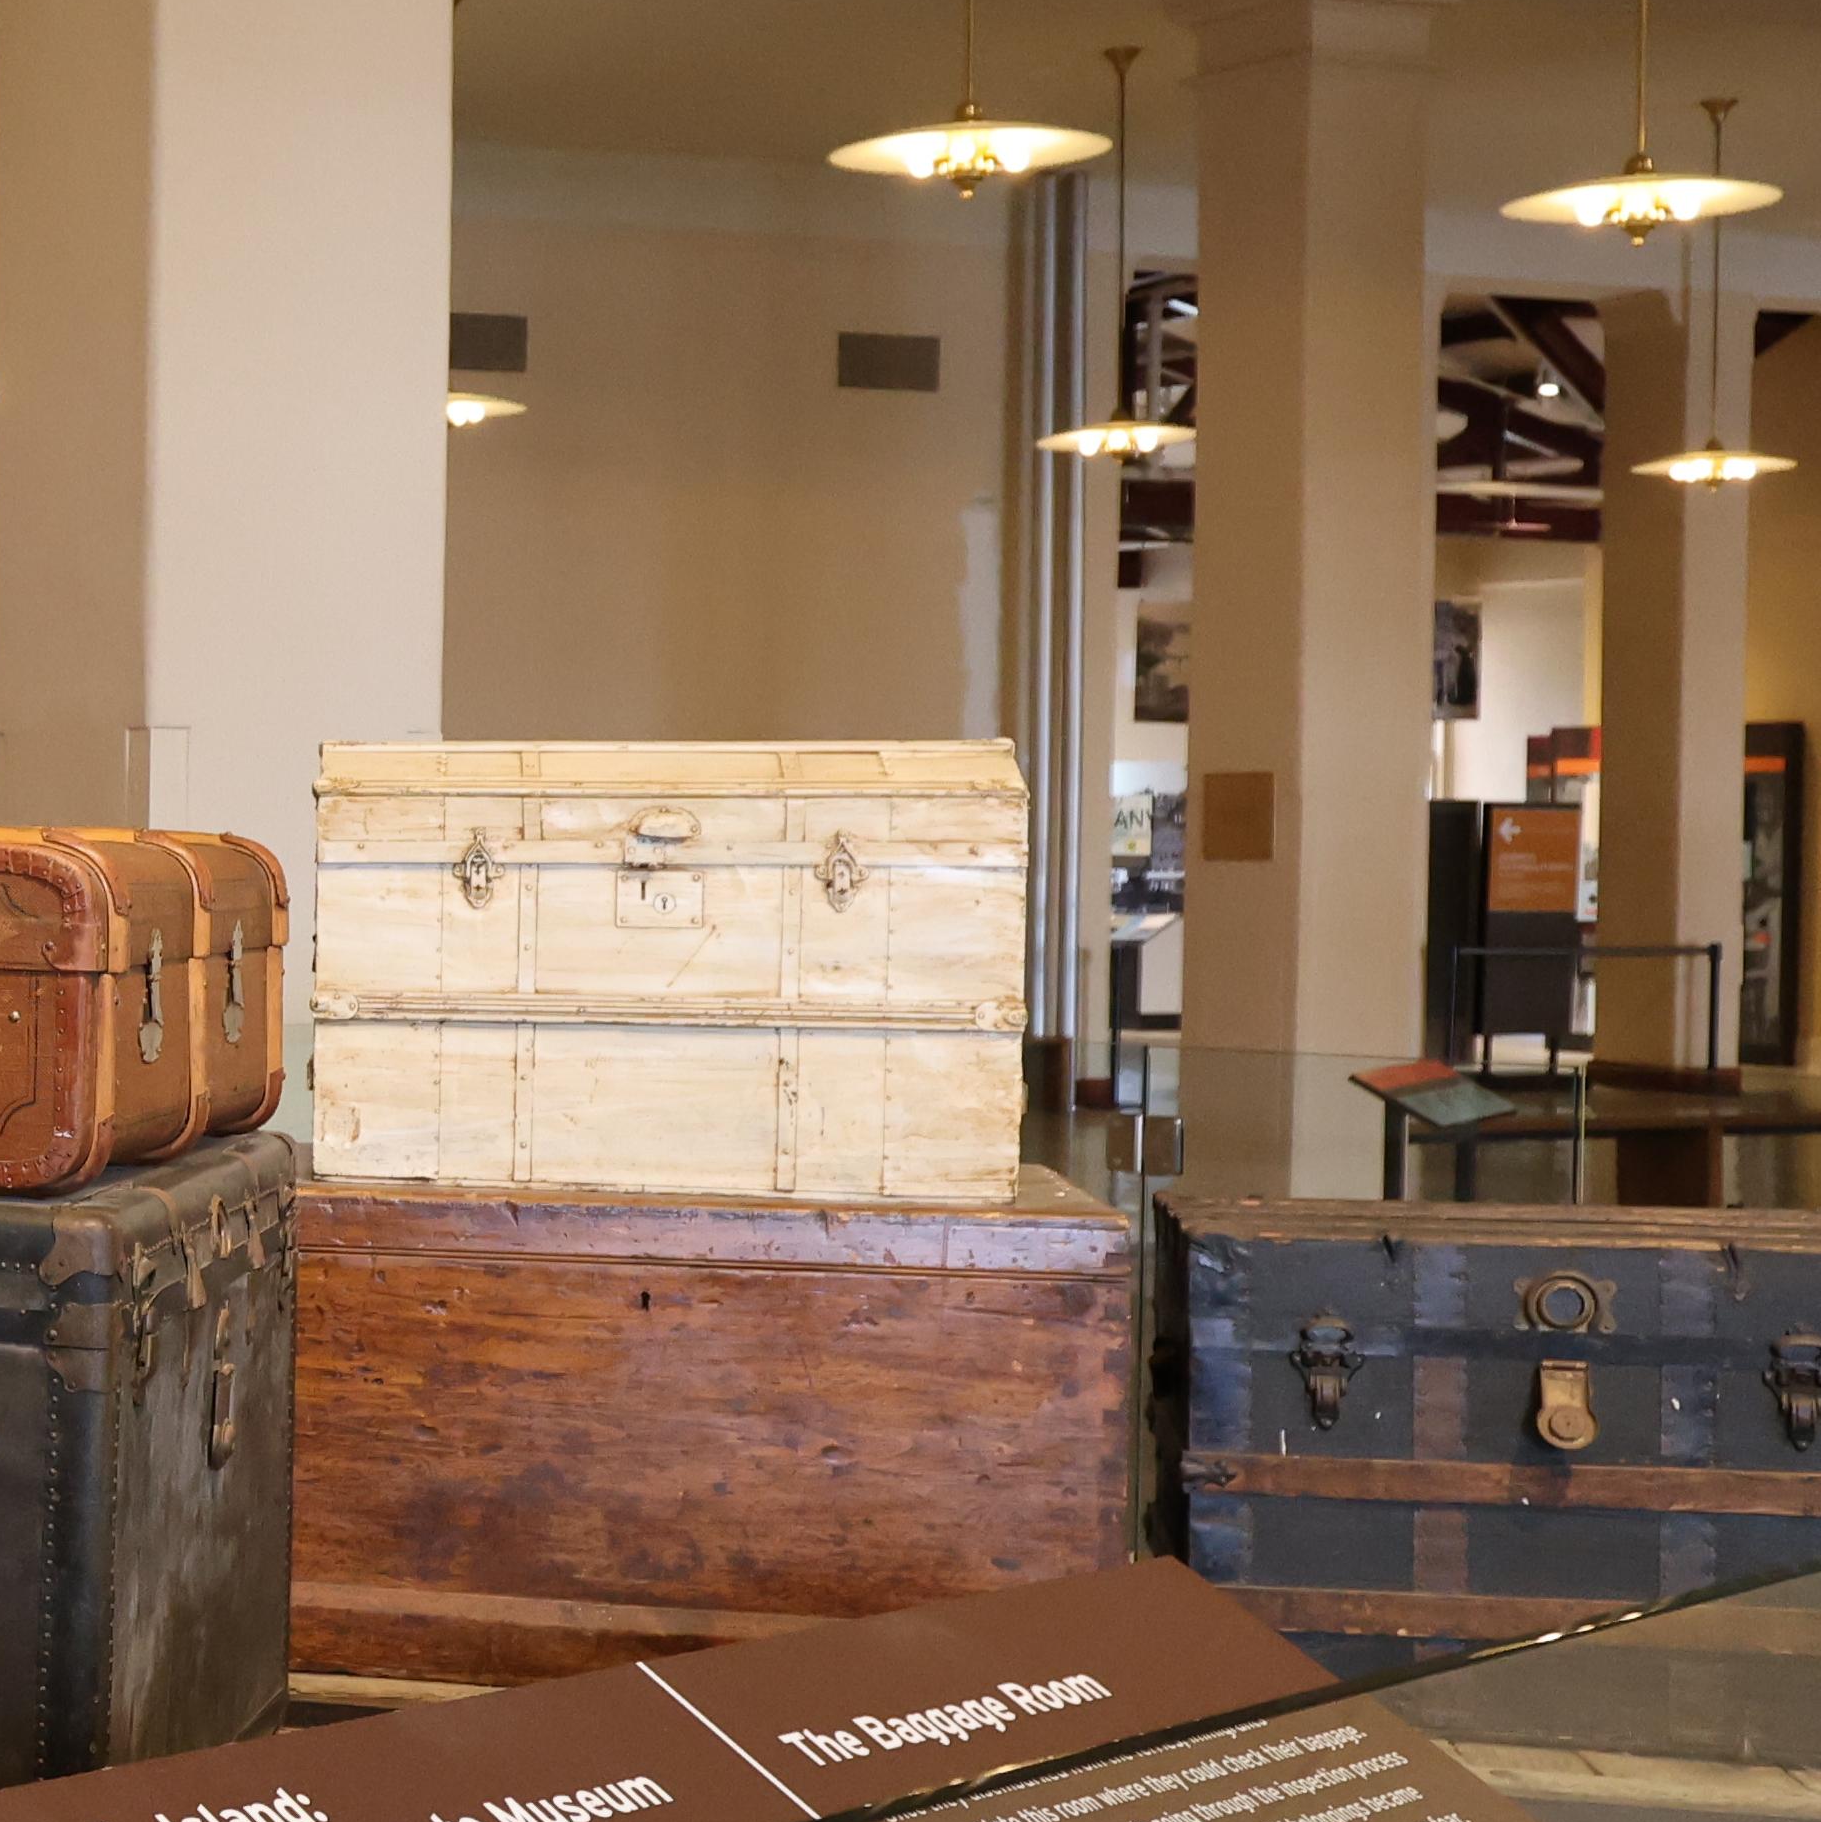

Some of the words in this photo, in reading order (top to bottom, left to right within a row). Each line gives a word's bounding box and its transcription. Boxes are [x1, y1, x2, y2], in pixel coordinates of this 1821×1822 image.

[776, 1727, 871, 1767] The
[851, 1695, 1017, 1751] Baggage
[996, 1673, 1113, 1716] Room
[1052, 1795, 1105, 1820] room
[1094, 1782, 1151, 1807] where
[1140, 1772, 1190, 1794] they
[1180, 1758, 1229, 1785] could
[1220, 1748, 1272, 1774] check
[1258, 1738, 1305, 1762] their
[1293, 1725, 1368, 1753] baggage.
[1188, 1790, 1260, 1822] through
[1247, 1785, 1286, 1805] the
[1272, 1766, 1357, 1798] inspection
[1348, 1750, 1409, 1781] process
